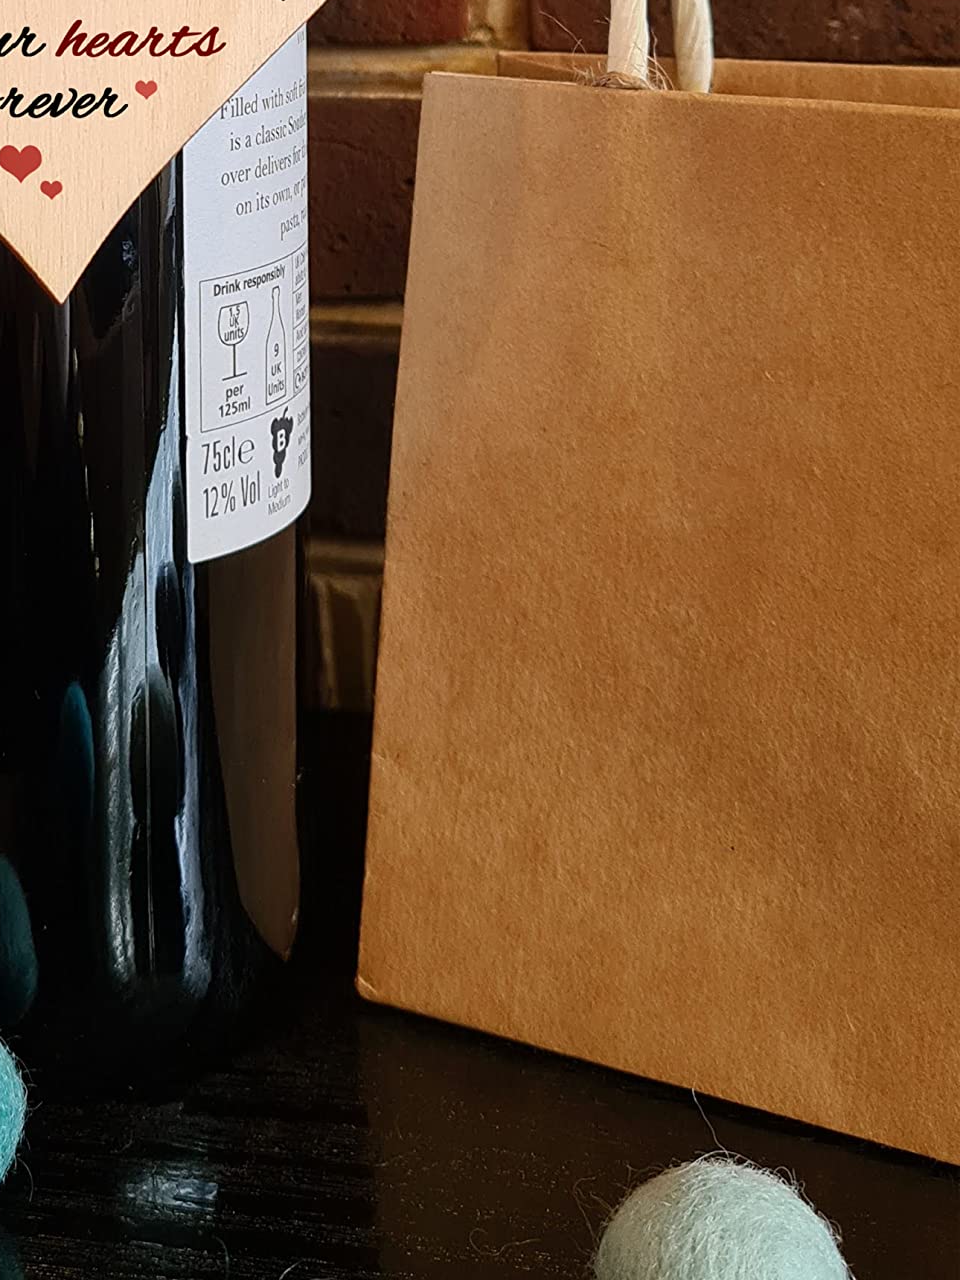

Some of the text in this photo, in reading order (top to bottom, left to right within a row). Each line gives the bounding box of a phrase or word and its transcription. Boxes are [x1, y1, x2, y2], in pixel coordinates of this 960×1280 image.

[54, 19, 227, 58] hearts
[220, 93, 258, 120] Filled
[262, 87, 284, 111] with
[230, 131, 241, 151] is
[245, 134, 252, 148] a
[255, 120, 287, 145] classic
[221, 167, 251, 186] over
[254, 155, 292, 179] delivers
[236, 200, 252, 216] on
[256, 191, 270, 211] its
[213, 279, 241, 297] Drink
[243, 264, 286, 290] responsibly
[224, 327, 245, 342] units
[274, 343, 280, 357] 9
[271, 361, 282, 376] UK
[226, 384, 244, 401] per
[268, 380, 285, 396] Units
[219, 396, 251, 418] 125ml
[277, 428, 286, 453] B
[203, 470, 261, 519] 12% Vol
